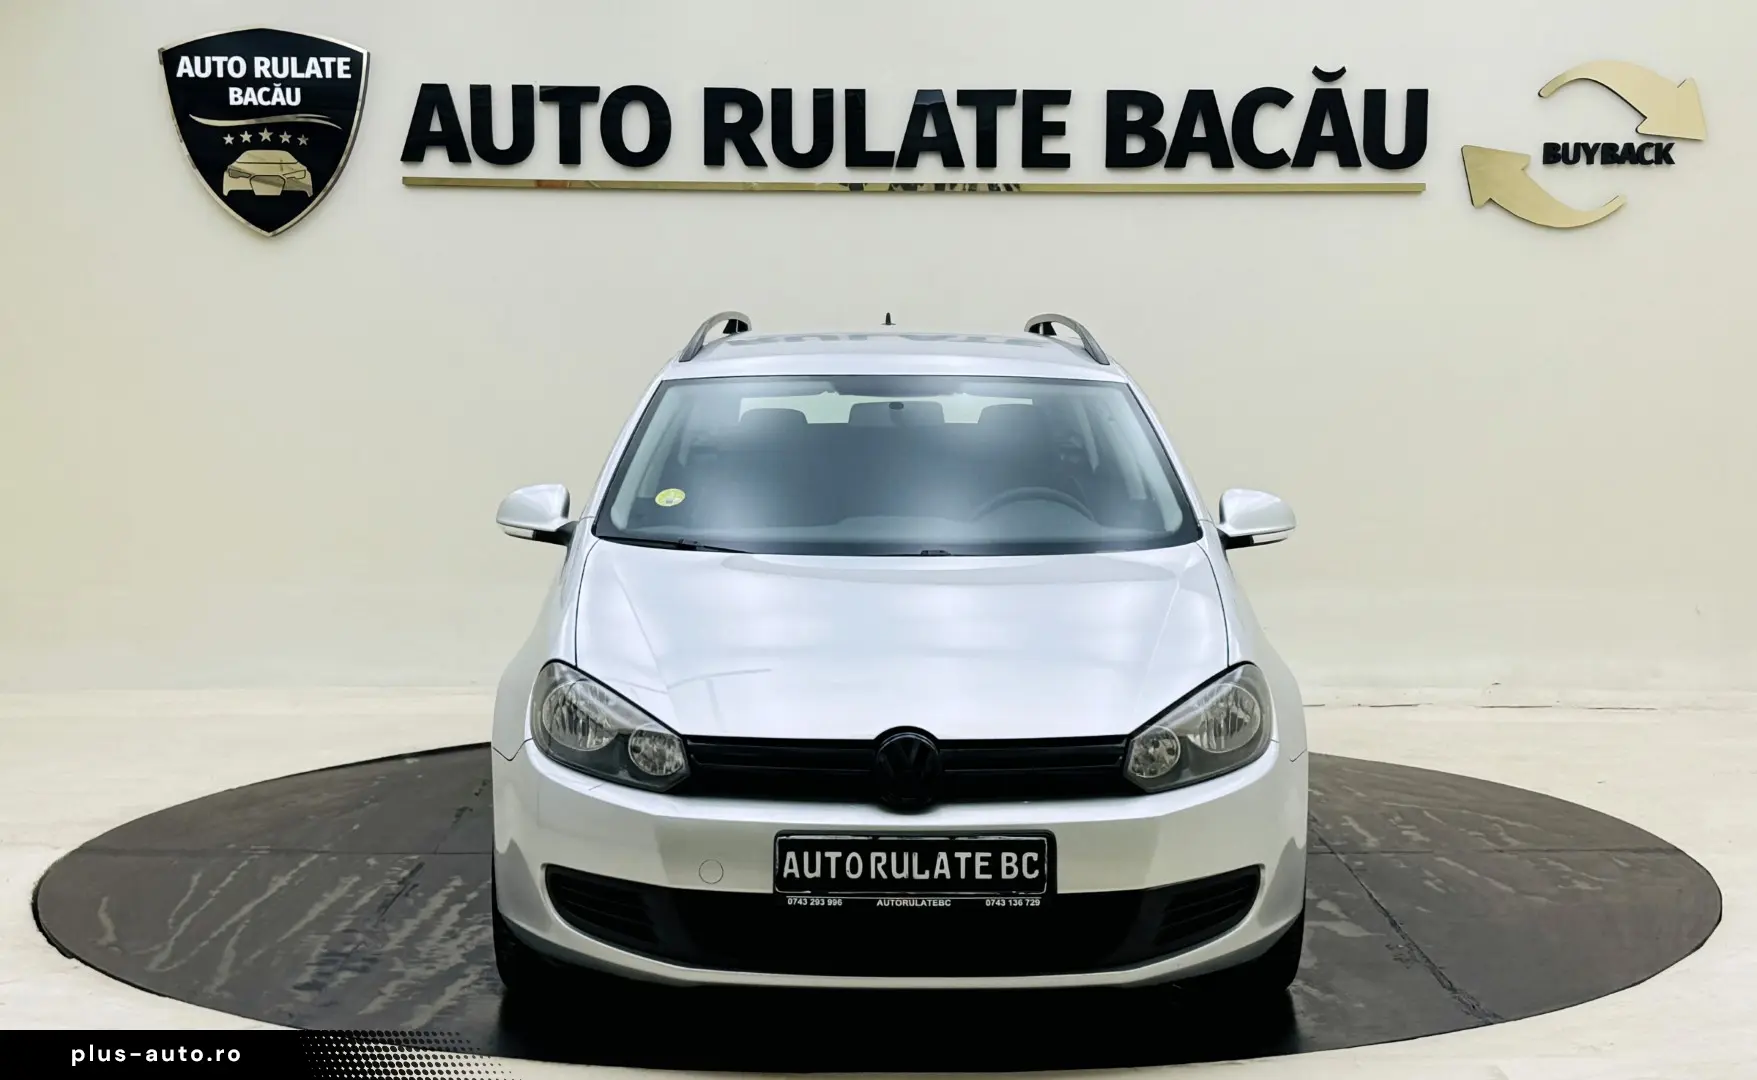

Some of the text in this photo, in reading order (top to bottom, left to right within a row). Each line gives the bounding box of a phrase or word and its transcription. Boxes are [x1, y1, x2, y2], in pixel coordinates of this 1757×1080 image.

[176, 56, 352, 78] AUTO RULATE
[228, 83, 302, 106] BACĂU
[400, 65, 1430, 171] AUTO RULATE BACĂU
[1542, 141, 1676, 167] BUYBACK
[783, 851, 1040, 880] AUTO RULATE BC
[787, 898, 808, 906] 0743
[876, 899, 952, 907] AUTORULATEBC
[985, 899, 1041, 907] 0743 136 729
